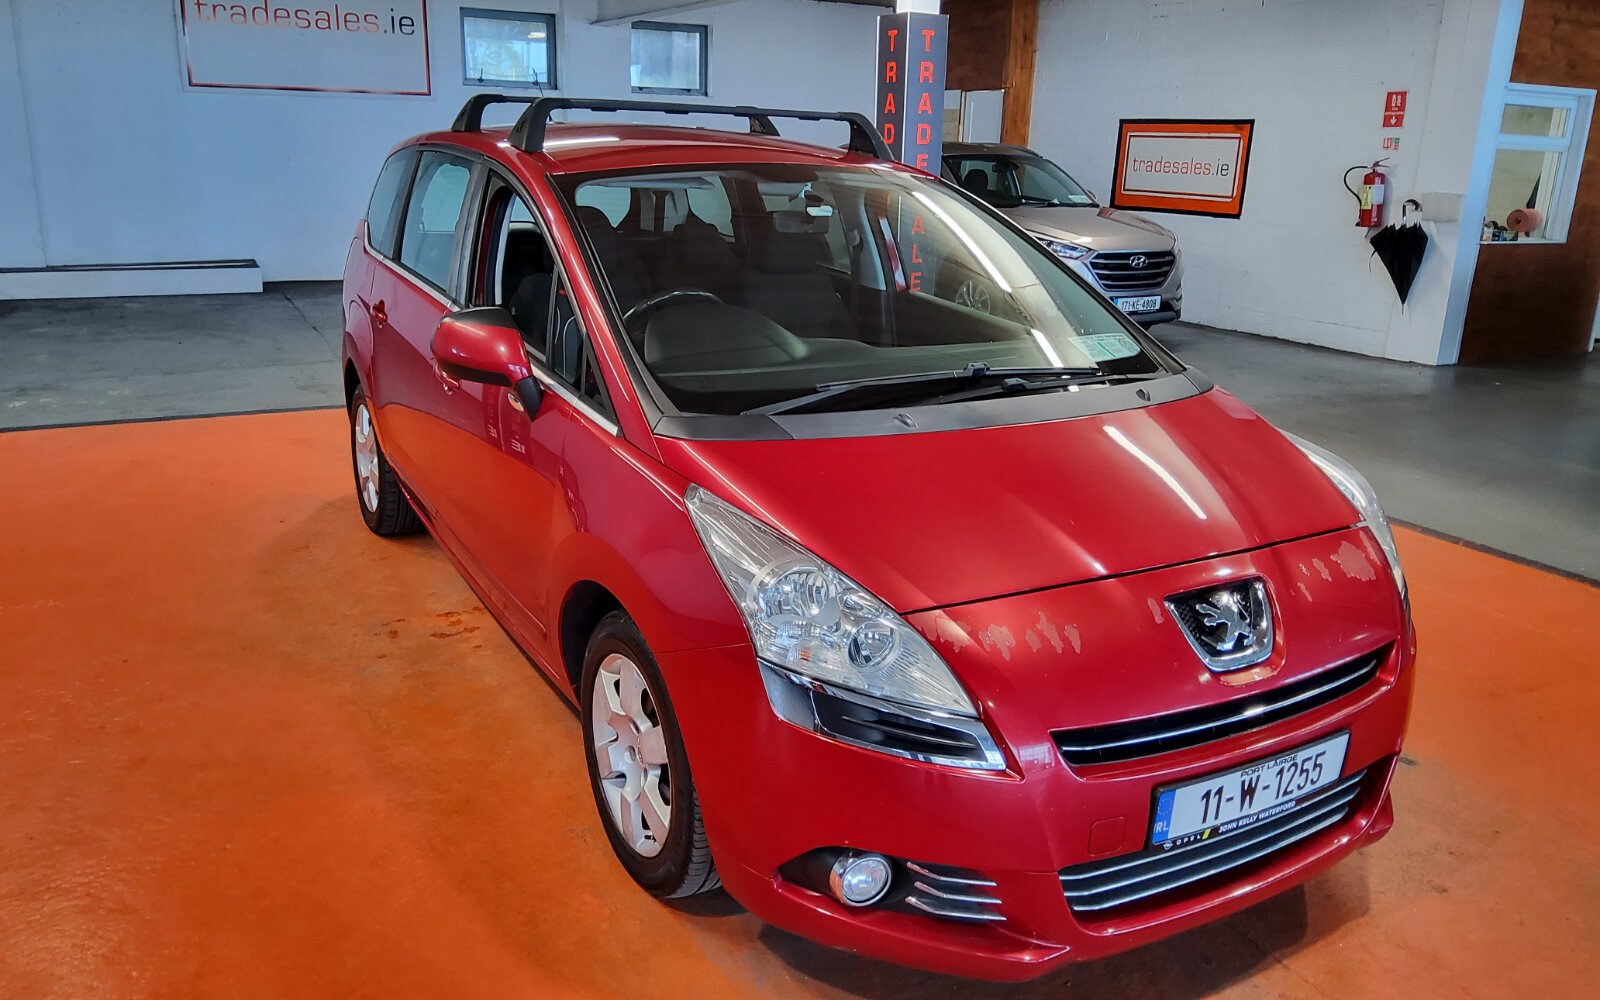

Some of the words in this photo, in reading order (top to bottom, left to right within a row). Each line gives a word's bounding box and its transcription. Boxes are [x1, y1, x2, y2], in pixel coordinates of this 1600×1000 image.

[194, 0, 415, 36] tradesales.ie
[884, 29, 898, 145] TRAD
[1132, 156, 1230, 177] tradesales.ie
[1201, 750, 1327, 825] 11-W-1255
[1240, 764, 1265, 778] PORT
[1218, 821, 1238, 834] JOHN
[1238, 814, 1258, 828] KELLY
[1259, 800, 1296, 820] WATERFORD
[1176, 834, 1202, 846] OPEL
